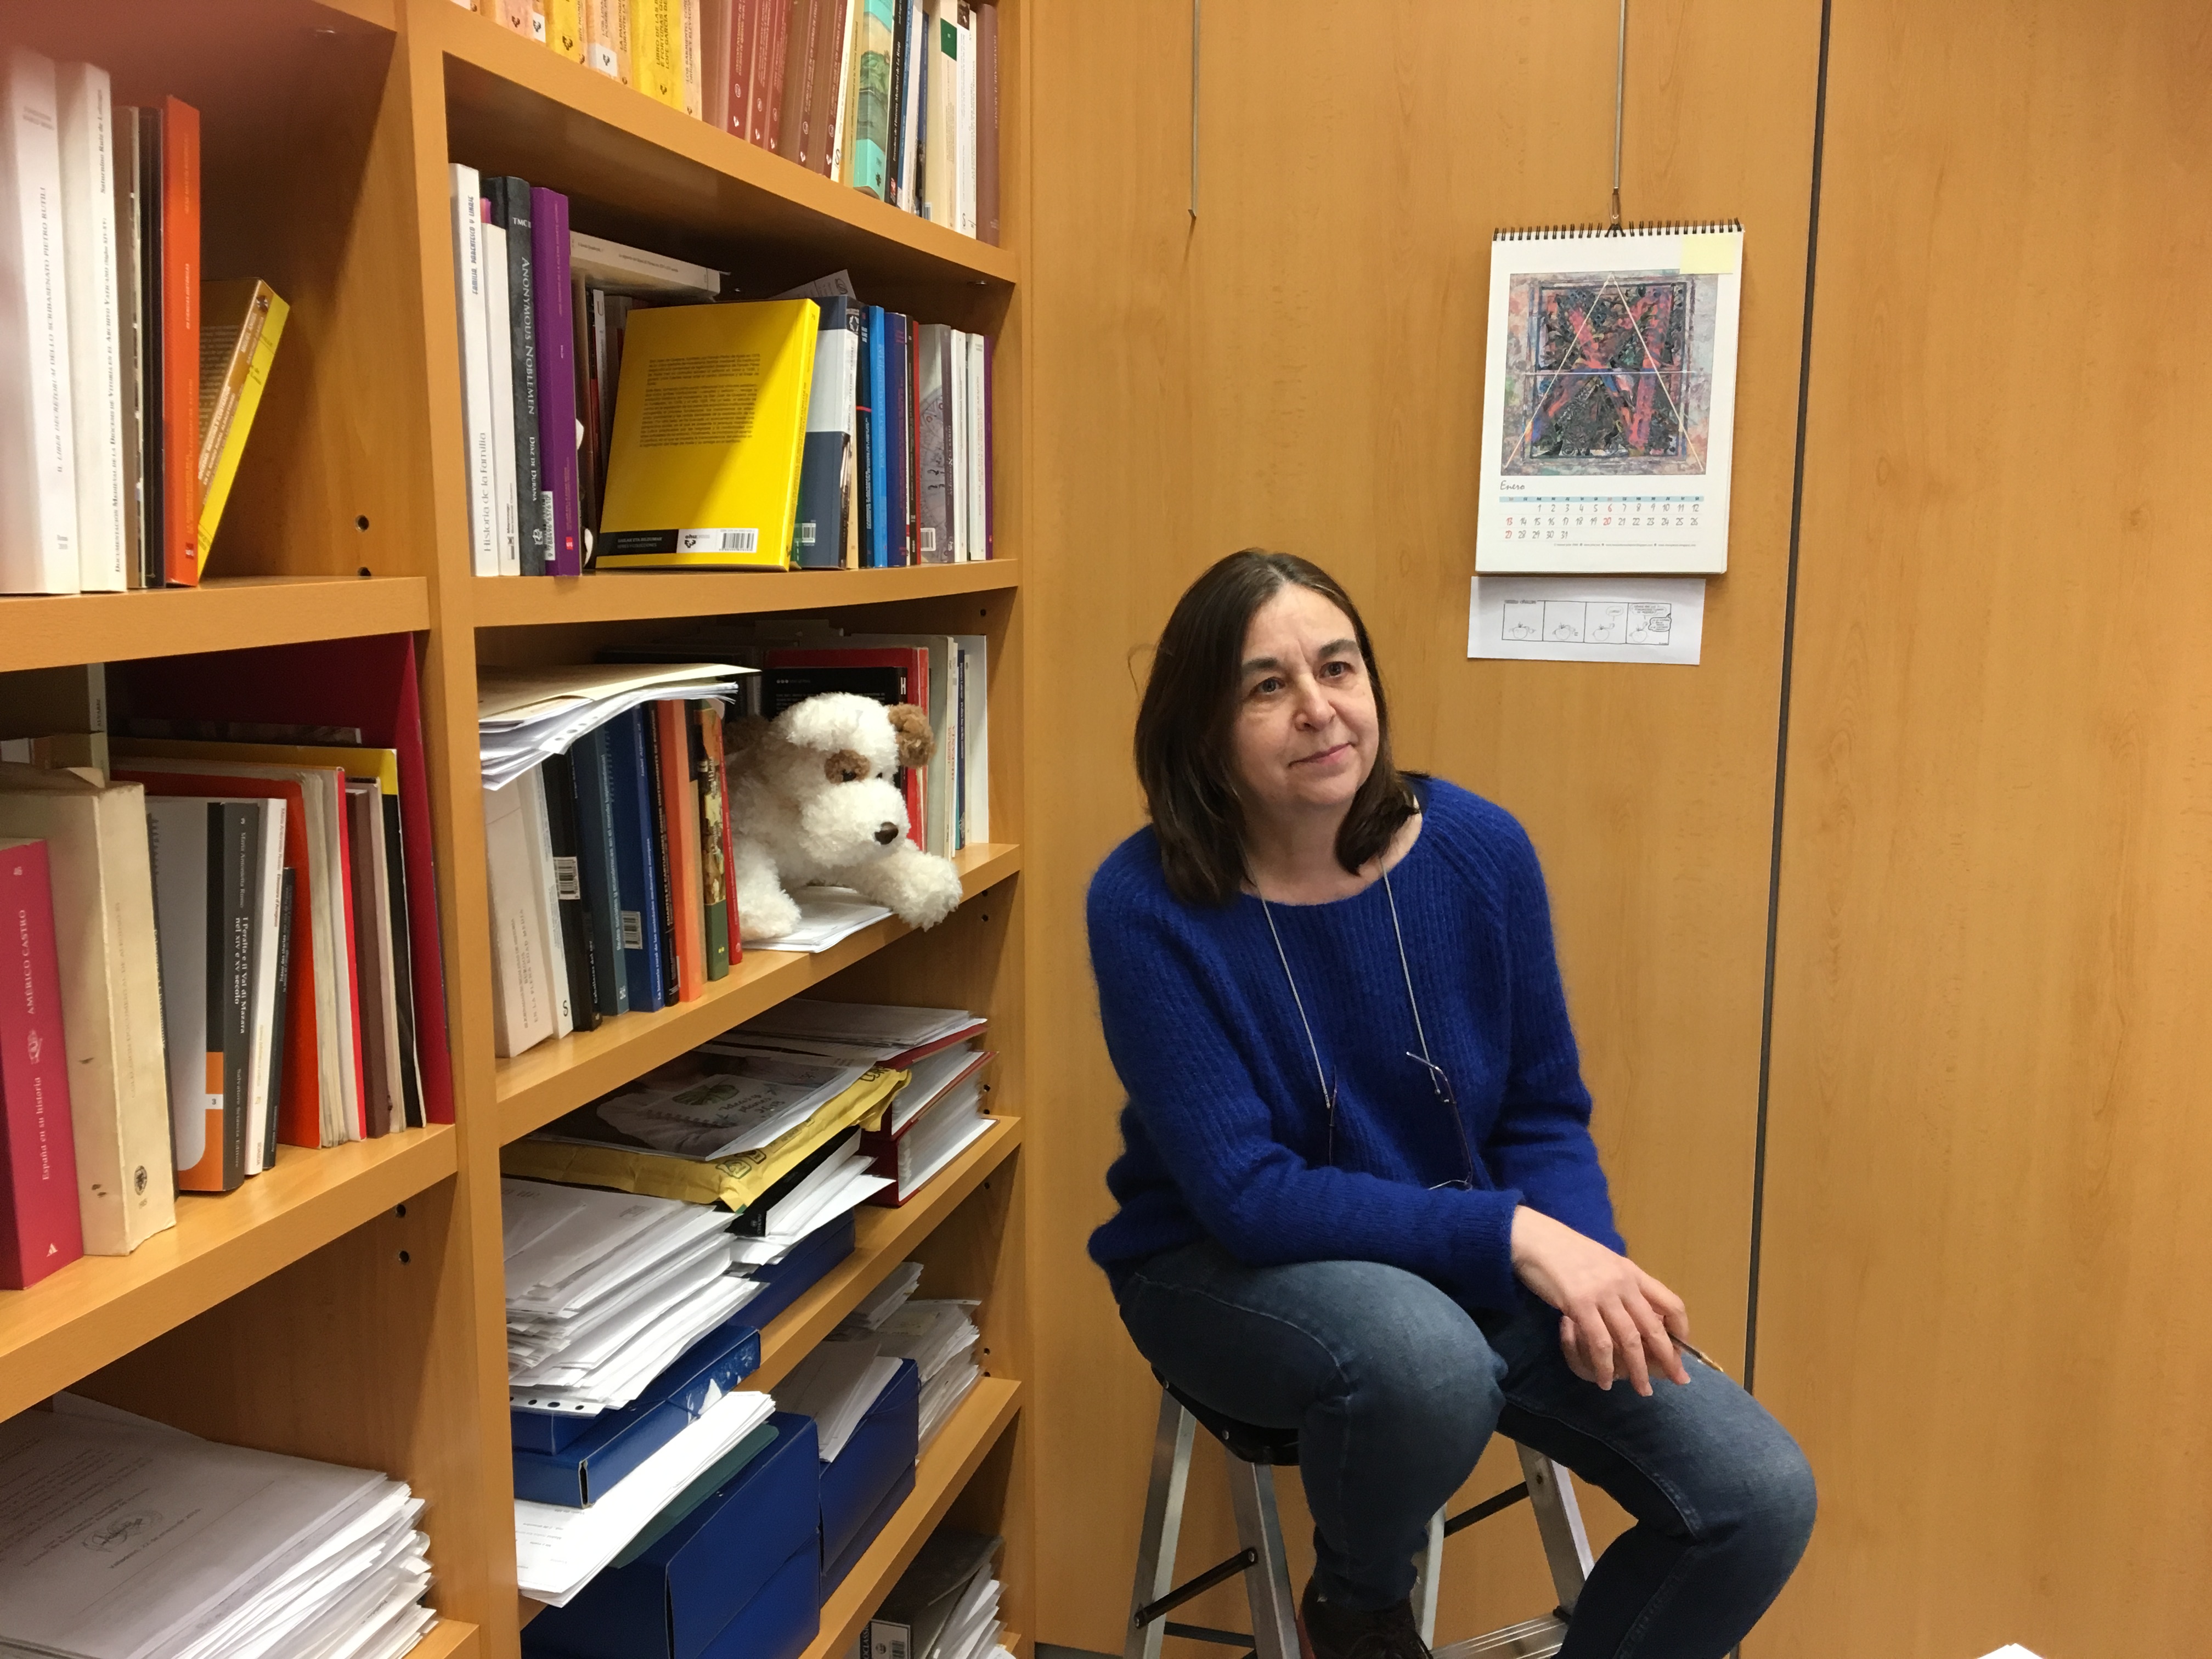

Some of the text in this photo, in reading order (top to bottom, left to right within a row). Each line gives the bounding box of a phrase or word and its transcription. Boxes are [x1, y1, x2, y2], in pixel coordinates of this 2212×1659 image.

[655, 25, 659, 37] DE
[521, 257, 535, 415] ANONYMOUS NOBLEMEN
[480, 476, 488, 487] la
[1499, 481, 1526, 492] Enero
[481, 489, 489, 504] de
[1537, 503, 1700, 513] 1 2 3 4 5 6 7 8 9 10 11 12
[1505, 516, 1699, 527] 13 14 15 16 17 18 19 20 21 22 23 24 25 26
[482, 506, 492, 551] Historia
[1504, 529, 1568, 540] 27 28 29 30 31
[18, 909, 36, 1015] AMÉRICO CASTRO
[241, 989, 246, 998] di
[234, 1068, 242, 1104] Salvatore
[33, 1077, 50, 1180] España en su historia
